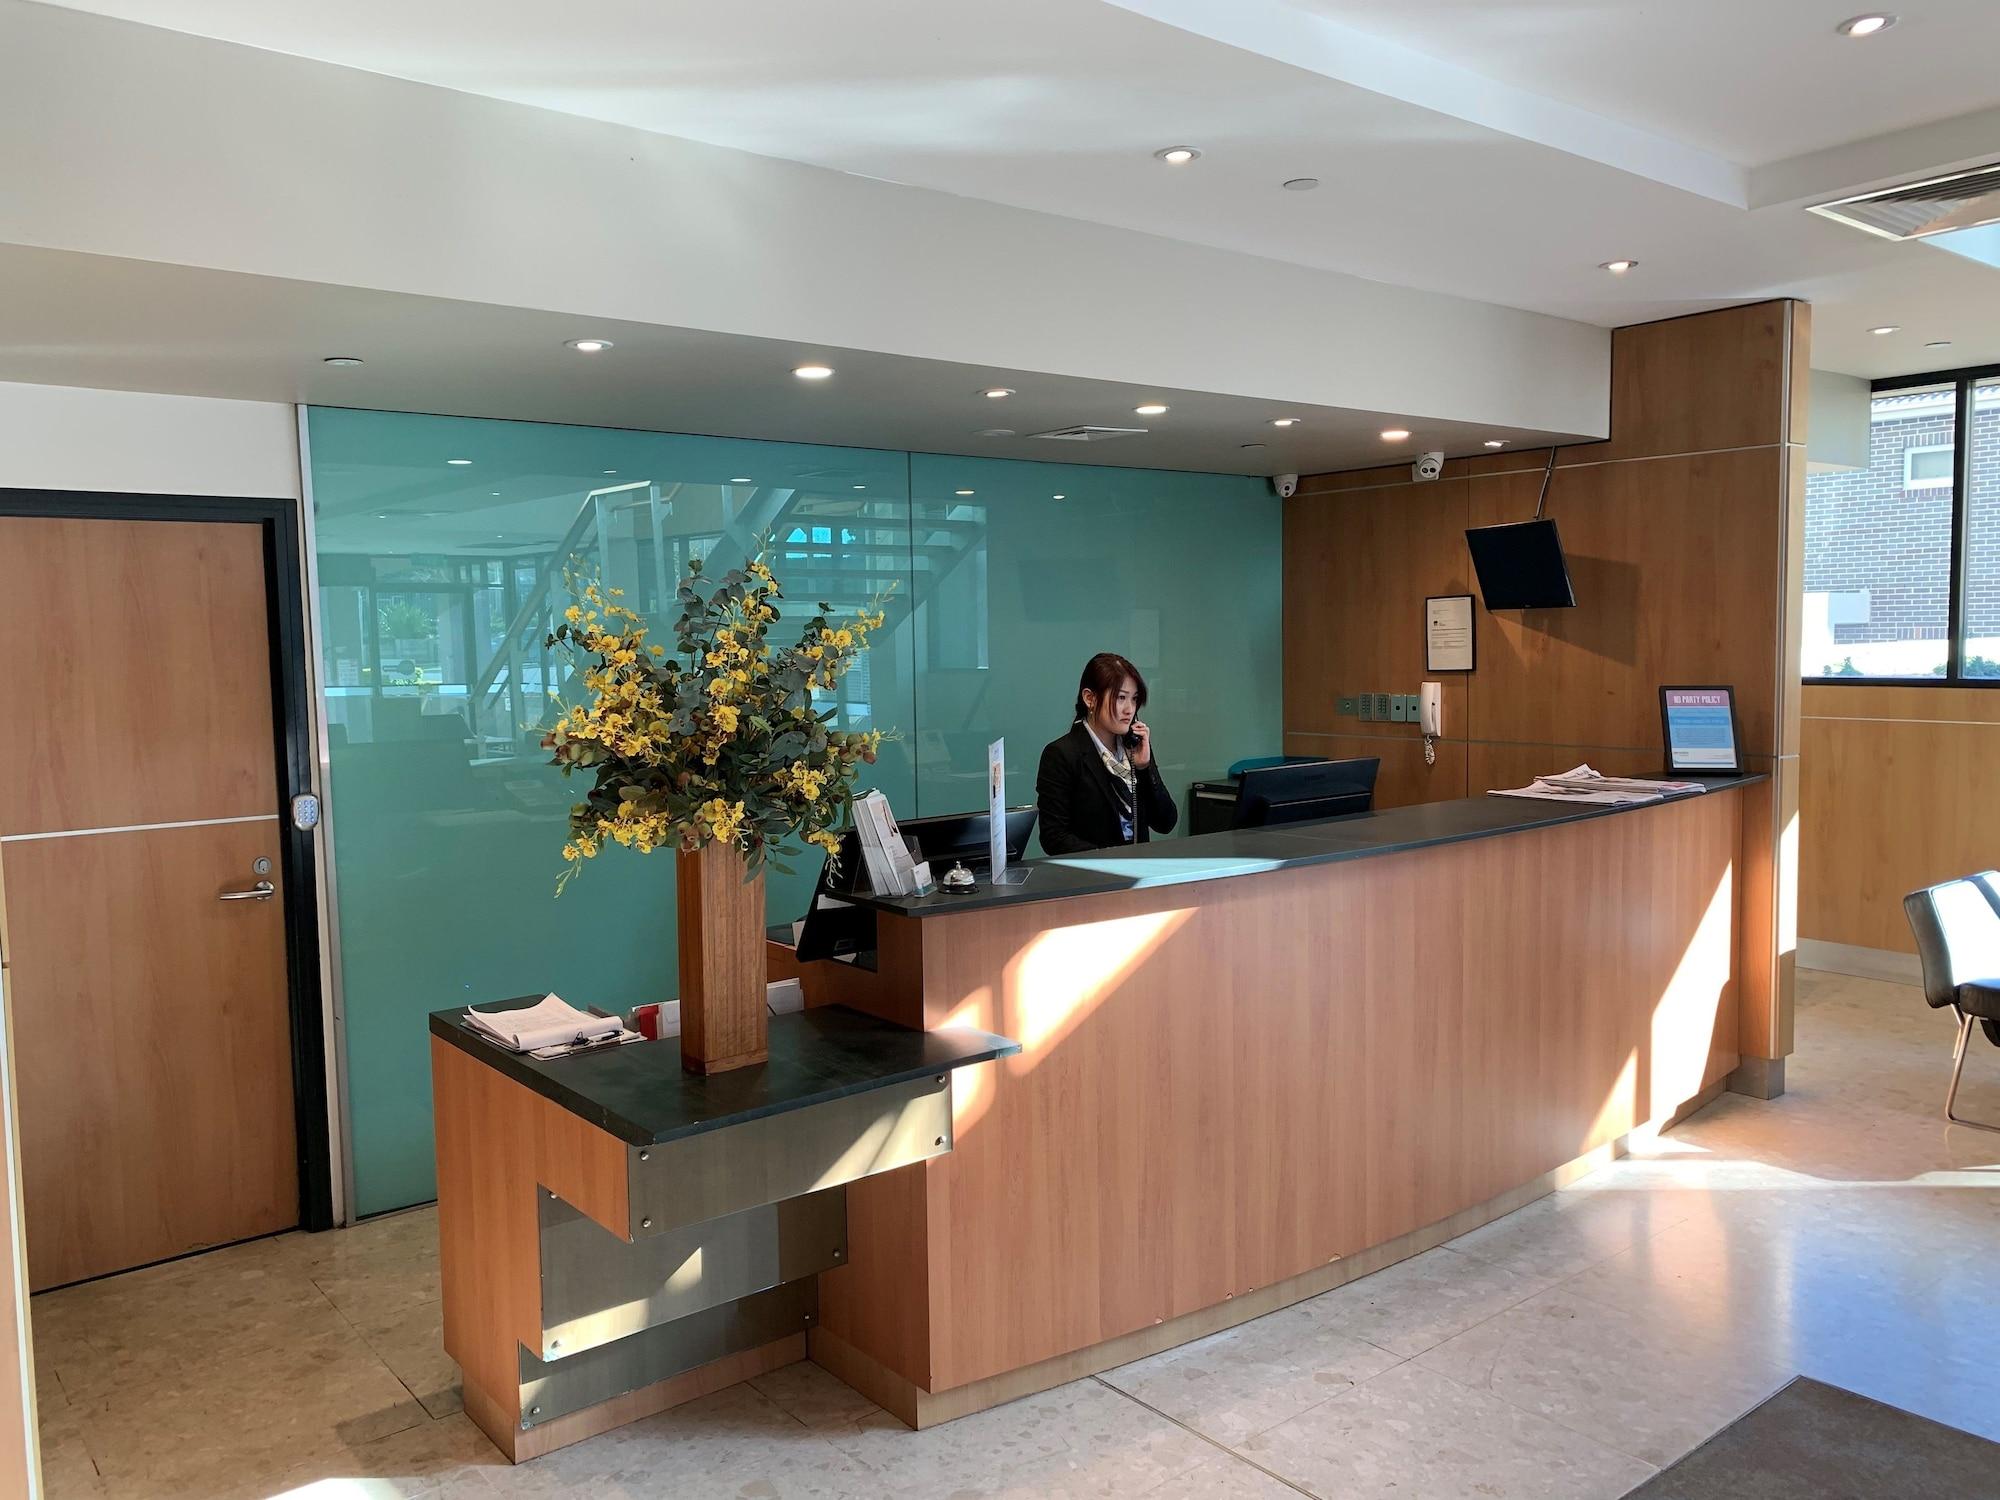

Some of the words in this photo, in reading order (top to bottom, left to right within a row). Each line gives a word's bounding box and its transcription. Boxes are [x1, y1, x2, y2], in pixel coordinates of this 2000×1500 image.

[1673, 695, 1681, 704] NO
[1682, 695, 1700, 704] PARTY
[1701, 695, 1721, 704] POLICY
